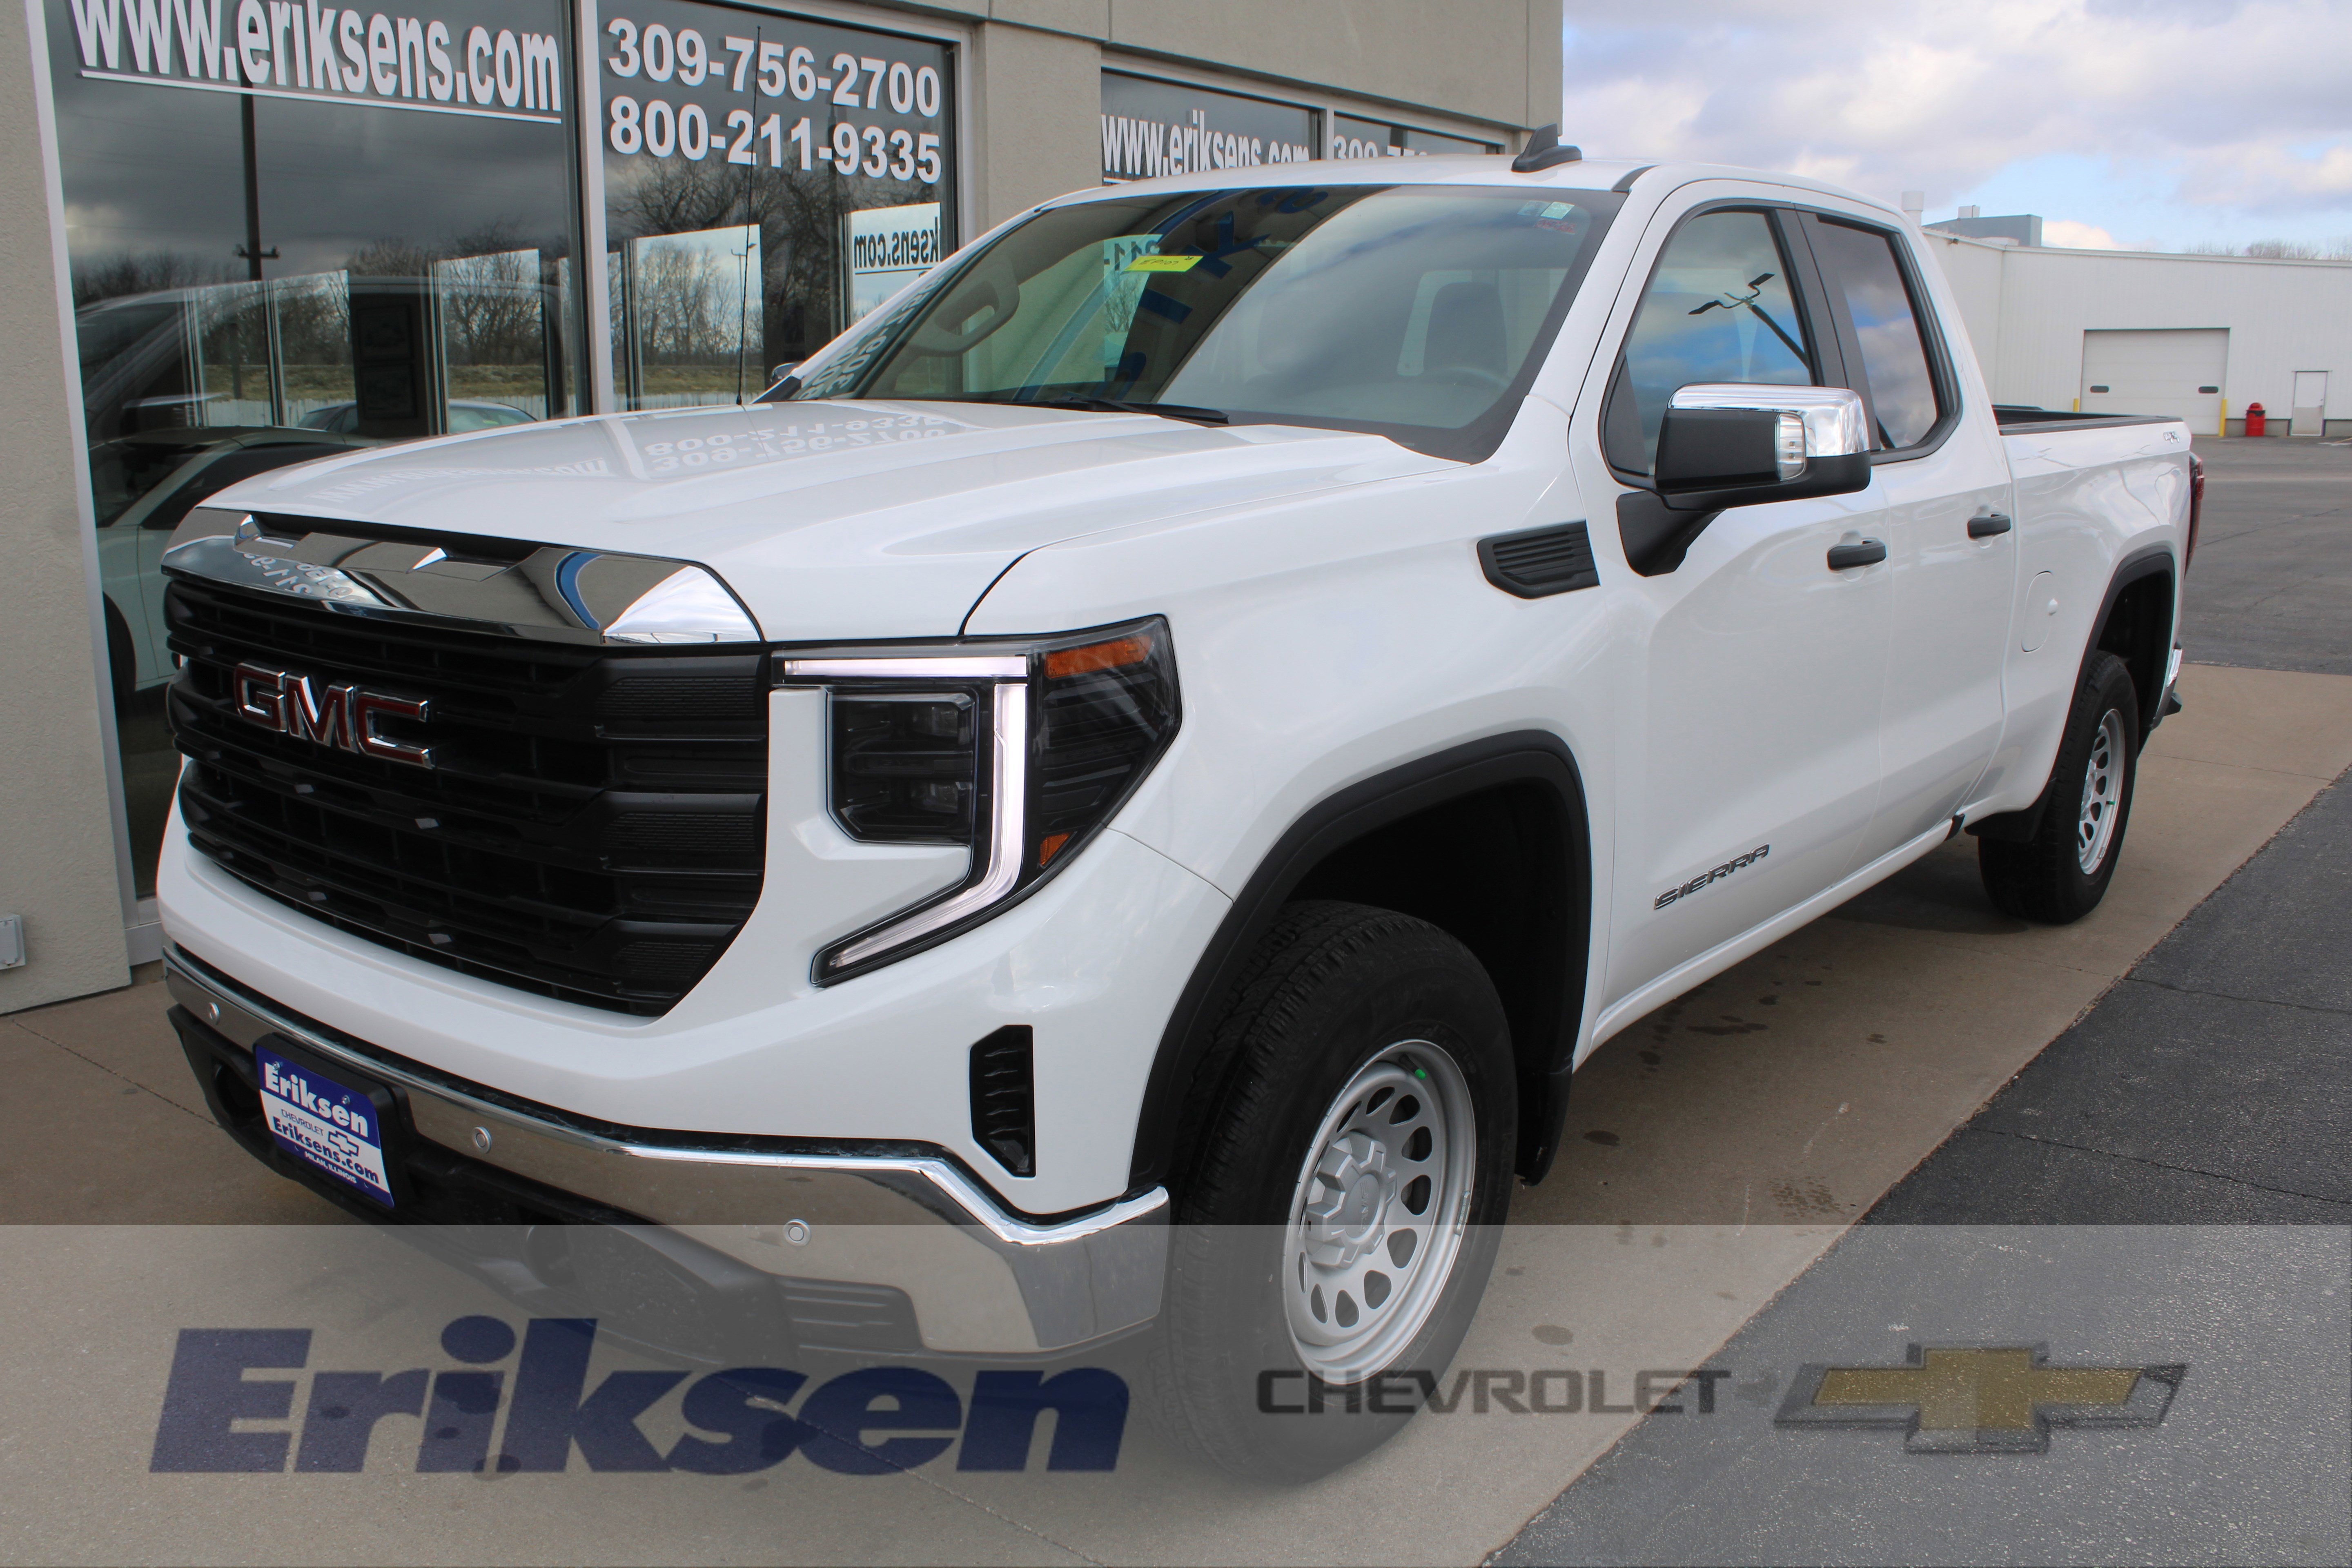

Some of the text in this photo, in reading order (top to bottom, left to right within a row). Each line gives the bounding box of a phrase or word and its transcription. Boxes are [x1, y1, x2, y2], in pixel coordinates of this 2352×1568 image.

[71, 0, 561, 111] www.eriksens.com
[608, 18, 940, 117] 309-756-2700
[610, 96, 942, 184] 800-211-9335
[1101, 109, 1309, 177] www.eriksensc
[234, 662, 434, 770] GMC
[1654, 842, 1770, 910] SIERRA
[264, 1062, 368, 1138] Eriksen
[281, 1108, 324, 1137] CHEVROLET
[272, 1116, 380, 1184] Eriksens.com
[304, 1151, 357, 1184] MILAN, ILLINOIS
